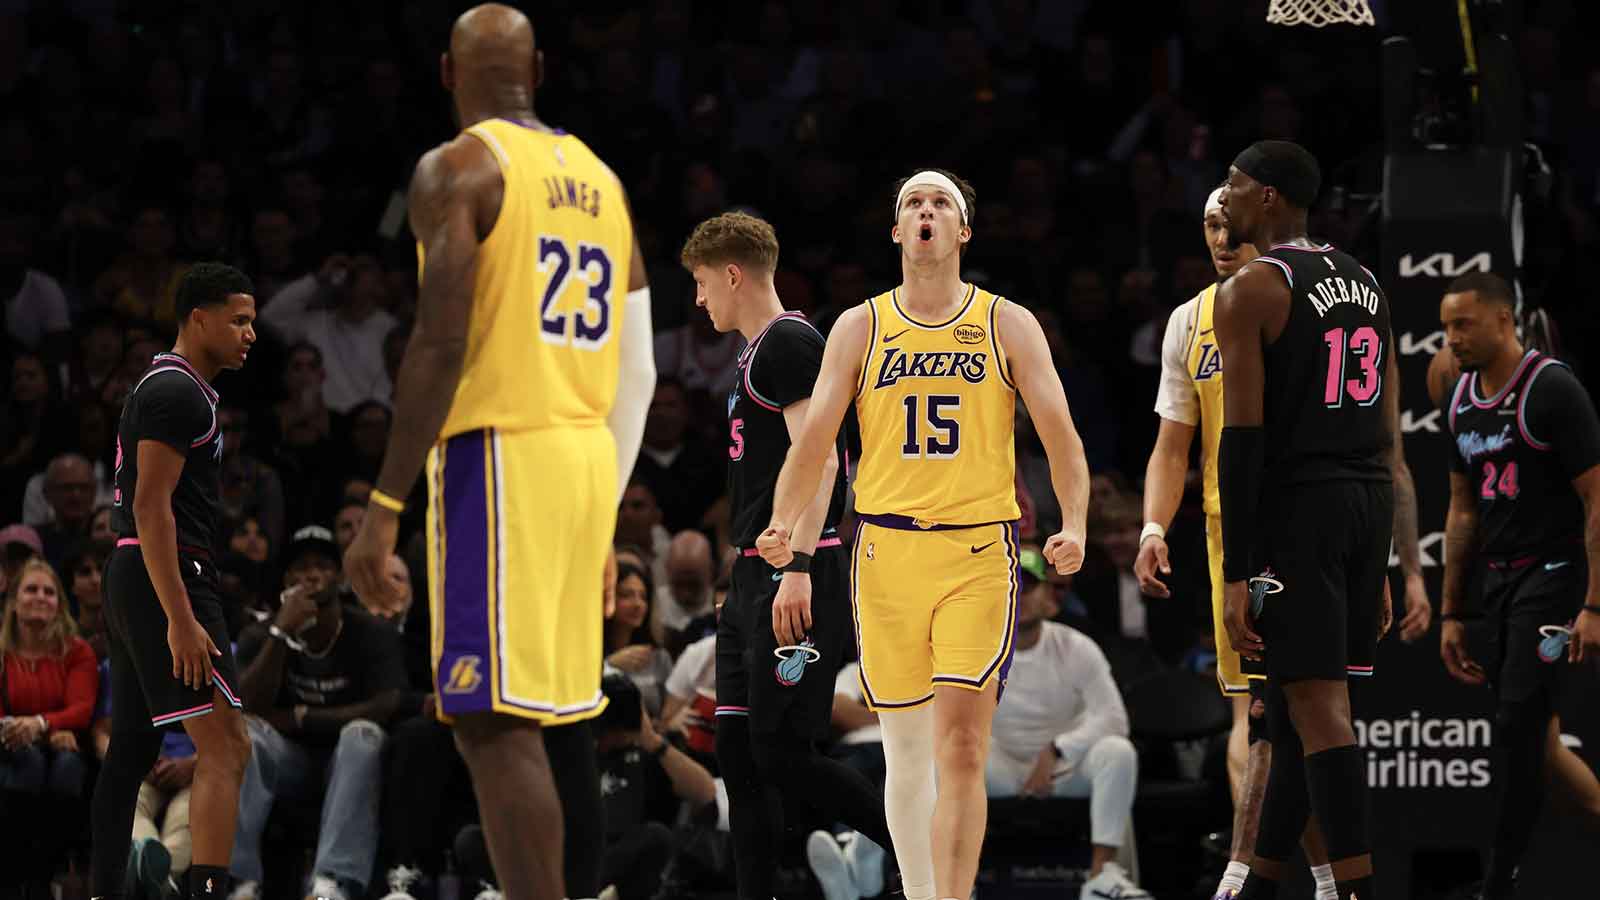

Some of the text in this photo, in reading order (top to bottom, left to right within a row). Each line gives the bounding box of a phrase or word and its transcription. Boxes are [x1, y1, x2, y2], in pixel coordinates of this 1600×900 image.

[544, 175, 601, 219] JAMES
[537, 233, 612, 349] 23
[1307, 277, 1379, 318] ADEBAYO
[956, 328, 984, 340] bibigo
[874, 347, 987, 390] LAKERS
[1324, 326, 1383, 409] 13
[902, 394, 961, 458] 15
[1480, 460, 1520, 500] 24
[1354, 710, 1492, 748] erican
[1367, 750, 1492, 788] irlines
